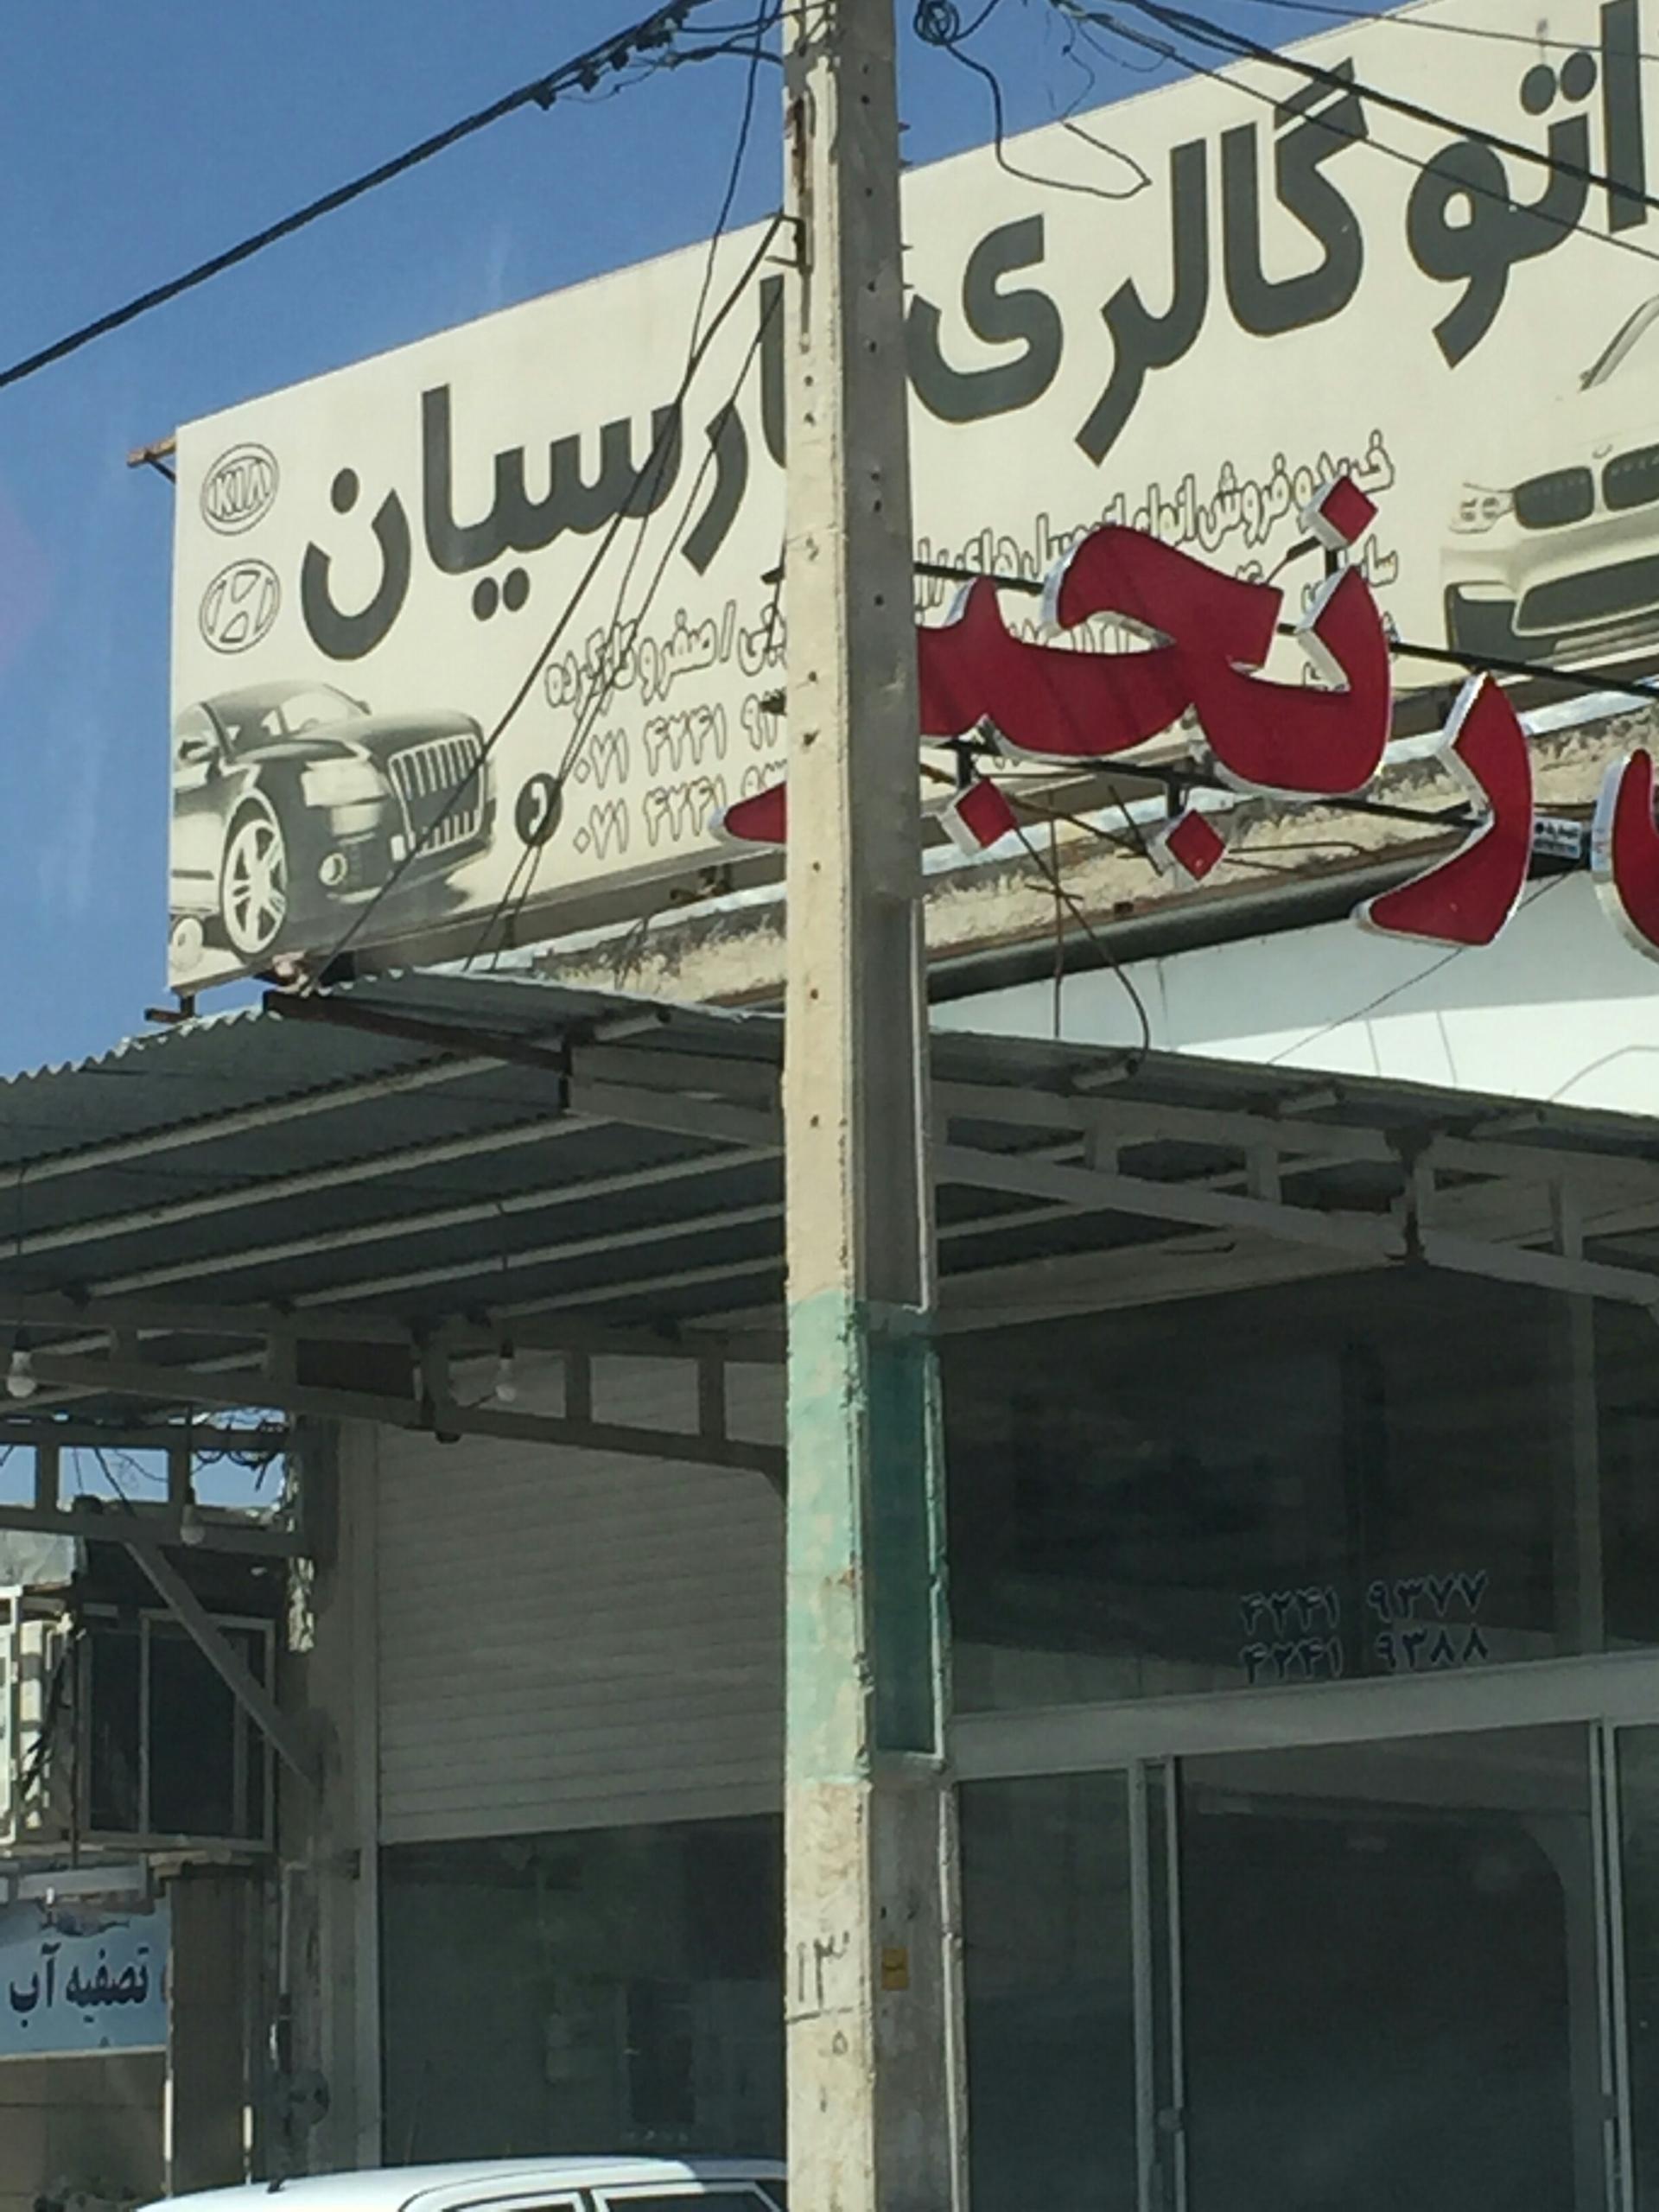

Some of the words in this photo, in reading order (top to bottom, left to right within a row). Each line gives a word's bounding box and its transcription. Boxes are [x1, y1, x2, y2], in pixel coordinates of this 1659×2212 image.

[1406, 0, 1647, 370] اتو
[902, 57, 1369, 468] گالری
[301, 269, 786, 662] ارسیان
[1198, 452, 1294, 554] فروش
[657, 607, 718, 702] صفر
[572, 728, 630, 790] ۰۷۱
[572, 798, 630, 861] ۰۷۱
[1367, 1569, 1488, 1624] ۹۳۷۷
[10, 1942, 62, 2029] آب
[66, 1946, 149, 2024] تصفیه
